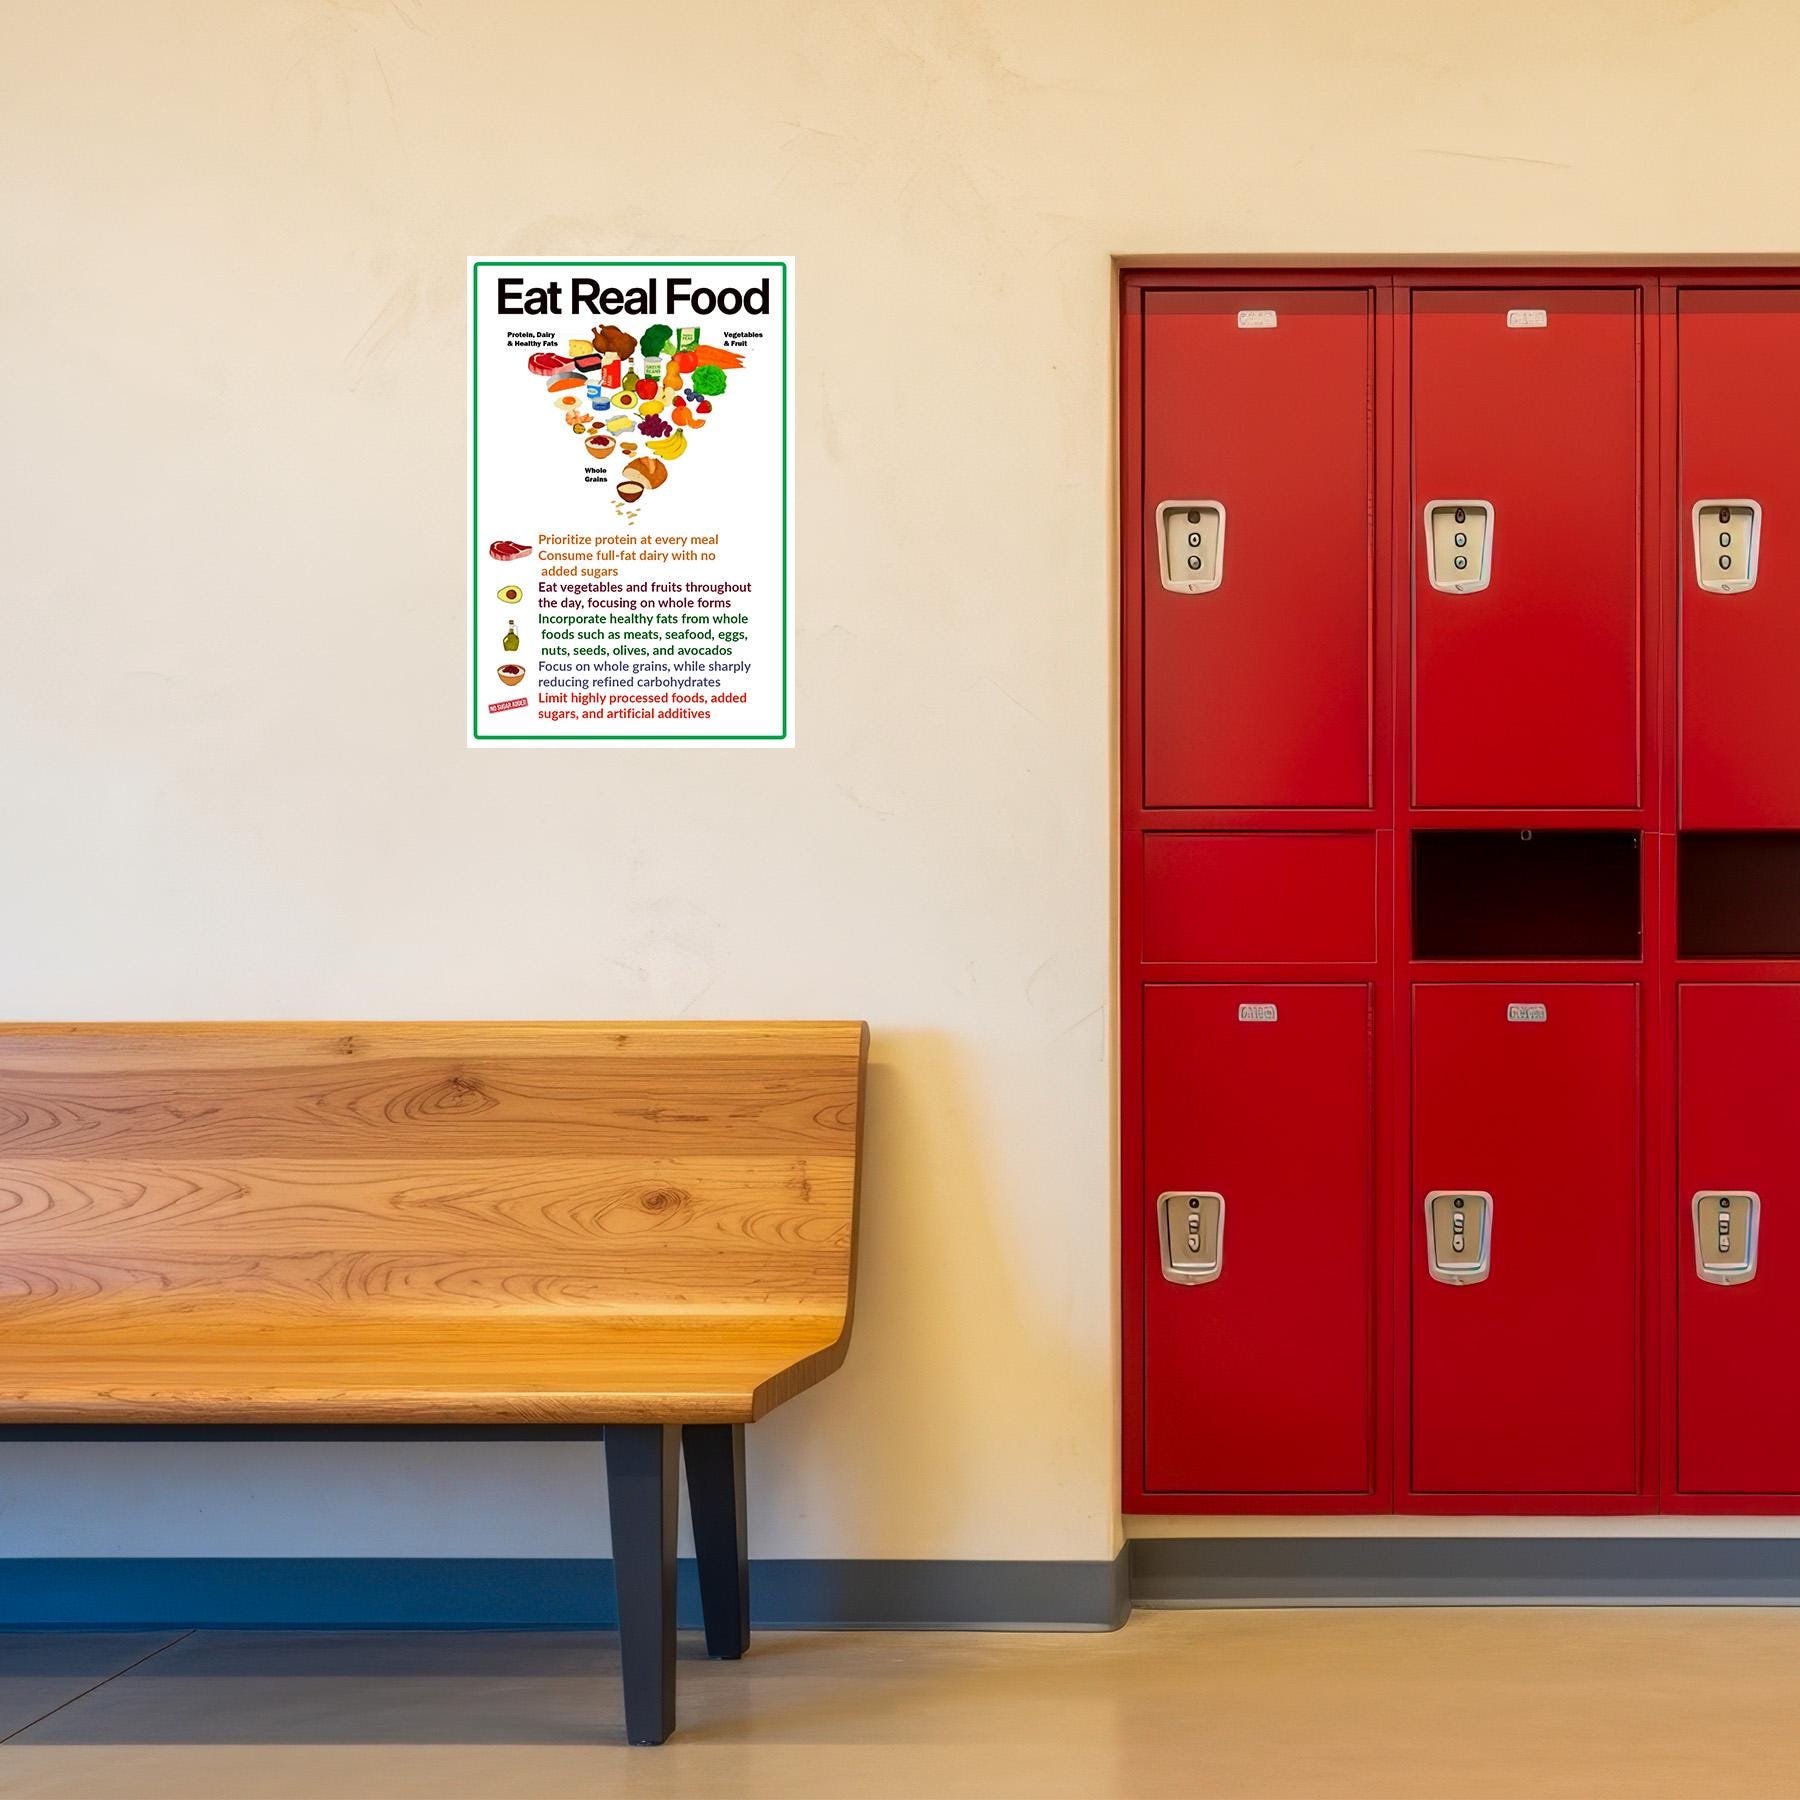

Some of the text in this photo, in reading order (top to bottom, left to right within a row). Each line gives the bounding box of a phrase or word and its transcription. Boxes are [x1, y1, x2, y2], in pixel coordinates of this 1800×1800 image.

[498, 278, 769, 315] Eat Real Food
[507, 331, 556, 339] Protein, Dairy
[723, 331, 764, 339] Vegetables
[514, 340, 542, 348] Healthy
[538, 534, 718, 546] Prioritize protein at every meal
[538, 551, 593, 560] Consume
[595, 550, 636, 560] full-fat
[639, 550, 668, 562] dairy
[671, 550, 697, 560] with
[541, 566, 618, 578] added sugars
[538, 582, 751, 595] Eat vegetables and fruits throughout
[537, 597, 731, 611] the day, focusing on whole forms
[538, 613, 748, 626] Incorporate healthy fats from whole
[541, 629, 574, 639] foods
[577, 629, 604, 639] such
[623, 630, 661, 641] meats,
[664, 629, 714, 642] seafood,
[717, 632, 747, 643] eggs,
[541, 645, 732, 657] nuts, seeds, olives, and avocados
[538, 661, 572, 671] Focus
[593, 661, 629, 671] whole
[632, 661, 670, 675] grains,
[673, 661, 705, 671] while
[708, 661, 751, 673] sharply
[538, 677, 720, 689] reducing refined carbohydrates
[538, 693, 746, 705] Limit highly processed foods, added
[538, 708, 710, 721] sugars, and artificial additives
